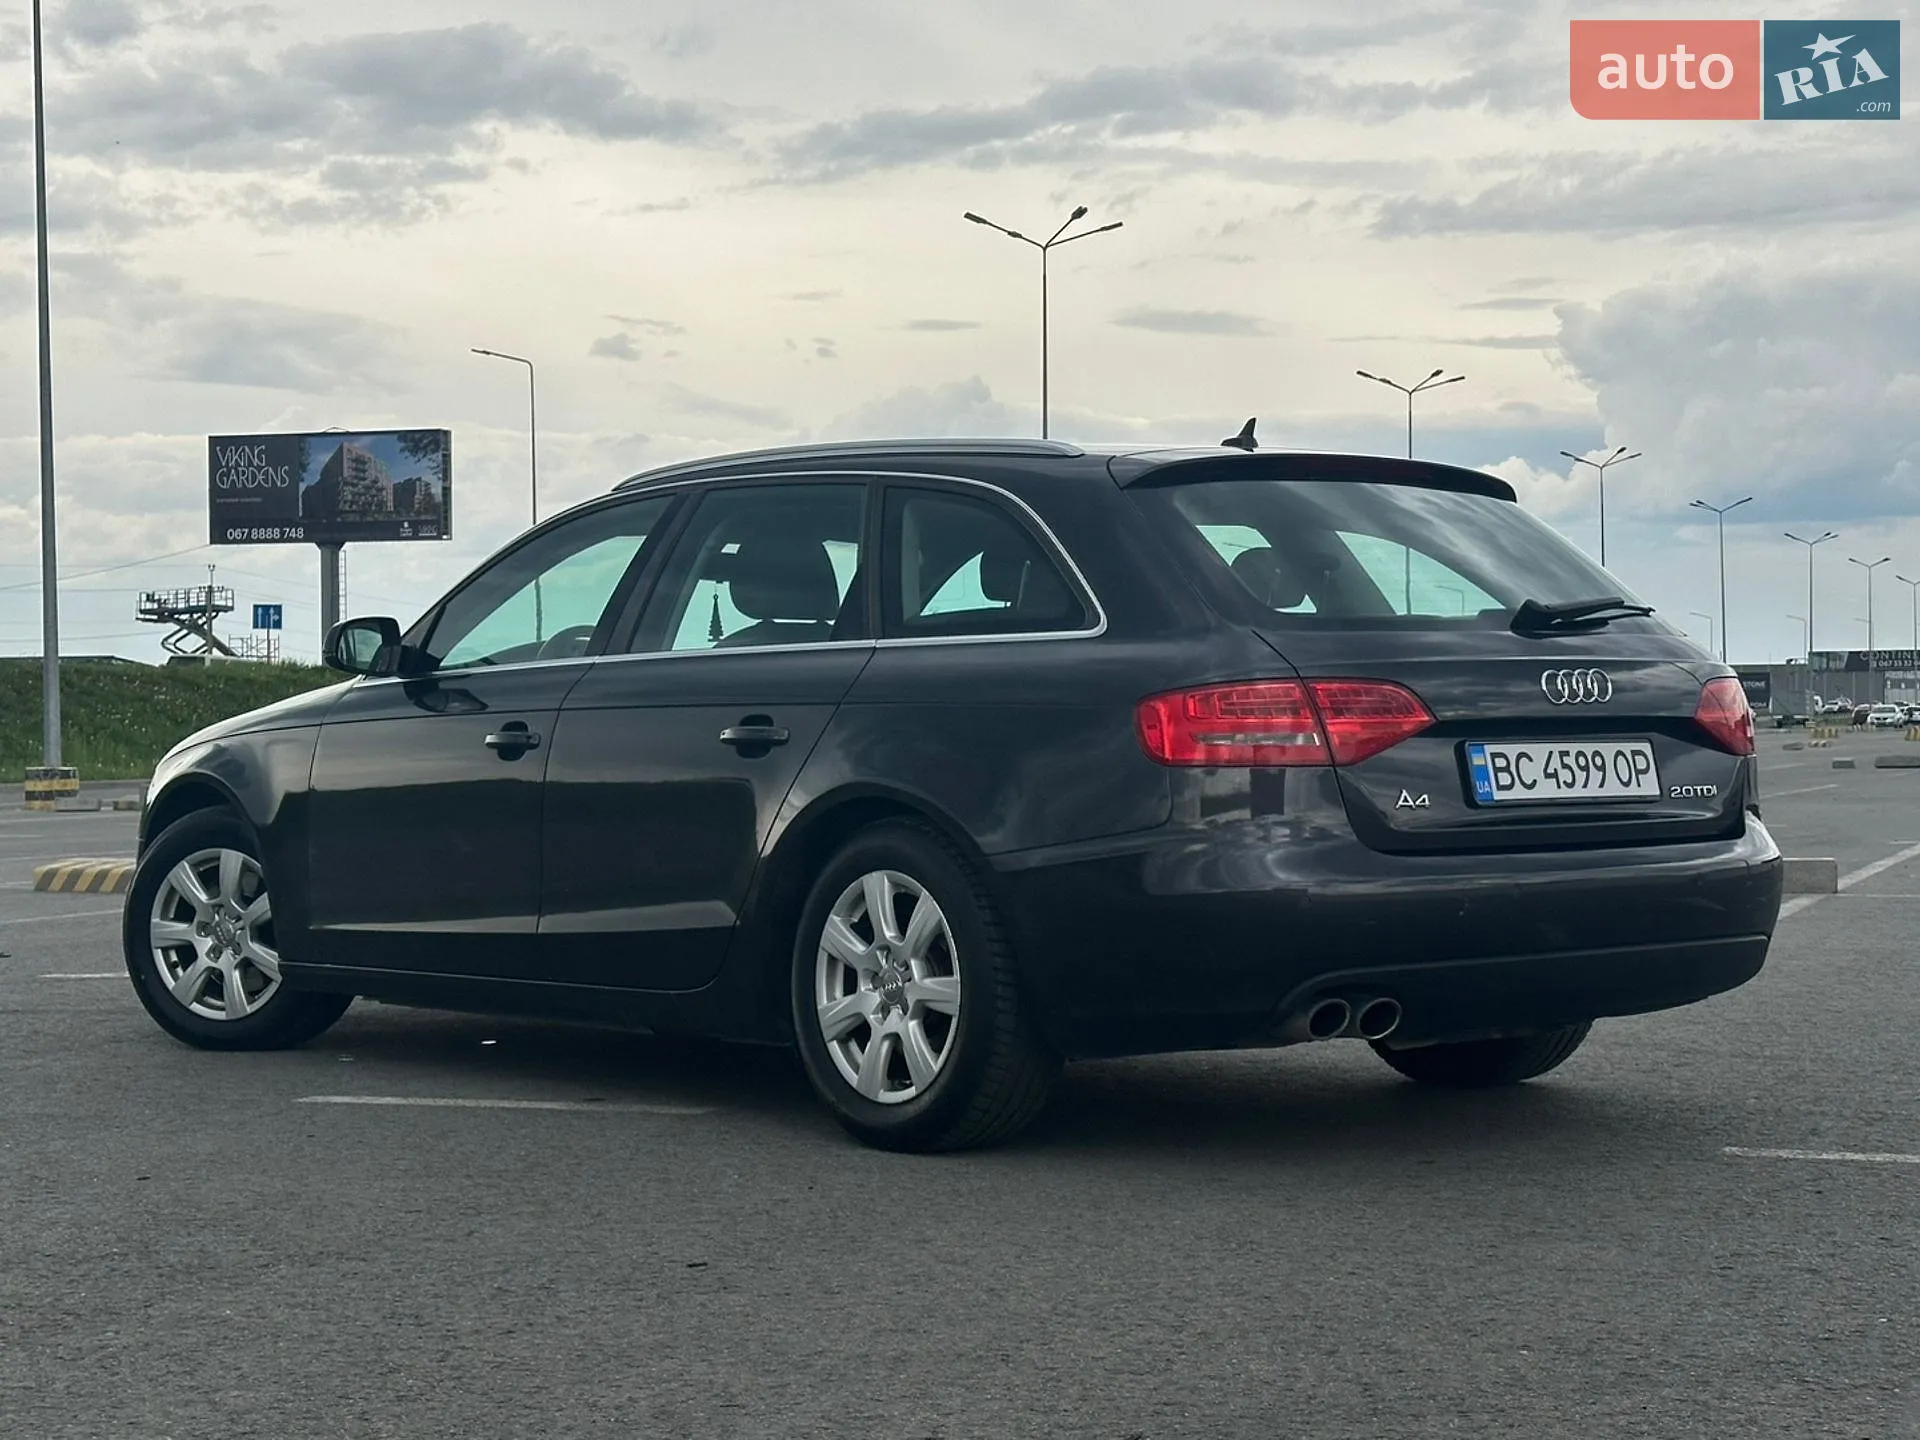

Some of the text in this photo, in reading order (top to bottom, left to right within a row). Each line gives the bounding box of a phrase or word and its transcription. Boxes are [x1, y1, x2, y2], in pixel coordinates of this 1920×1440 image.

[216, 445, 266, 467] VIKING
[215, 466, 289, 489] GARDENS
[227, 527, 304, 540] 067 8888 748
[1490, 749, 1651, 791] BC 4599 OP
[1476, 781, 1491, 793] UA
[1395, 789, 1430, 809] A4
